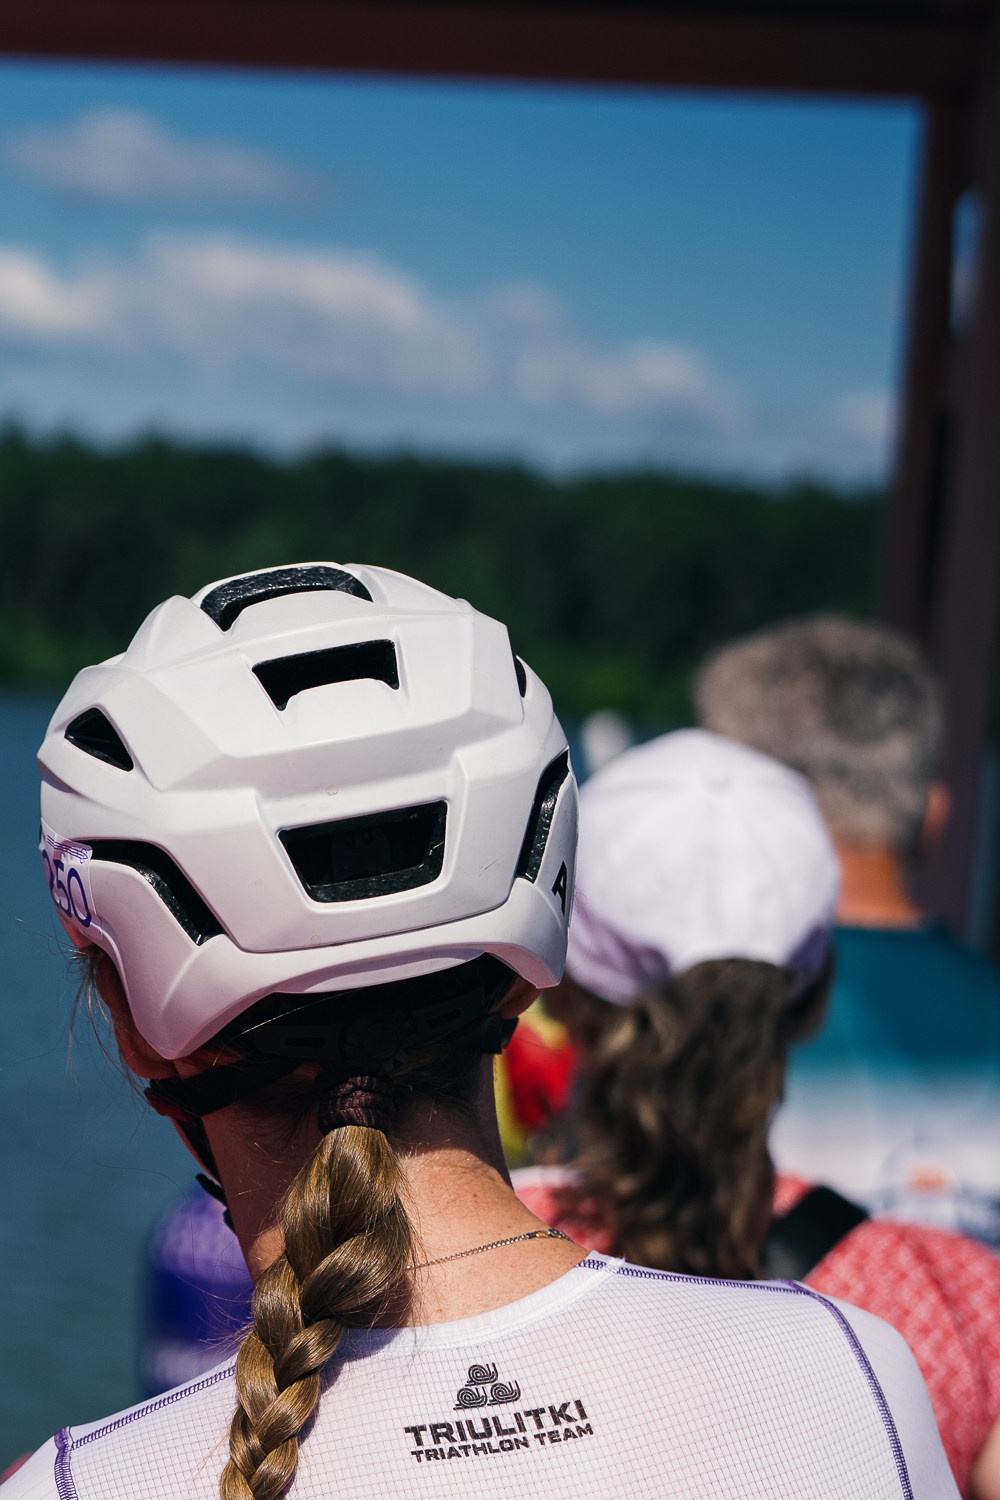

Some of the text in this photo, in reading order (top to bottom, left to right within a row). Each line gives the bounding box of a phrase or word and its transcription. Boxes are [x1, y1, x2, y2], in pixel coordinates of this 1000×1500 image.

[404, 1399, 589, 1447] TRIULITKI
[410, 1422, 595, 1463] TRIATHLON TEAM
